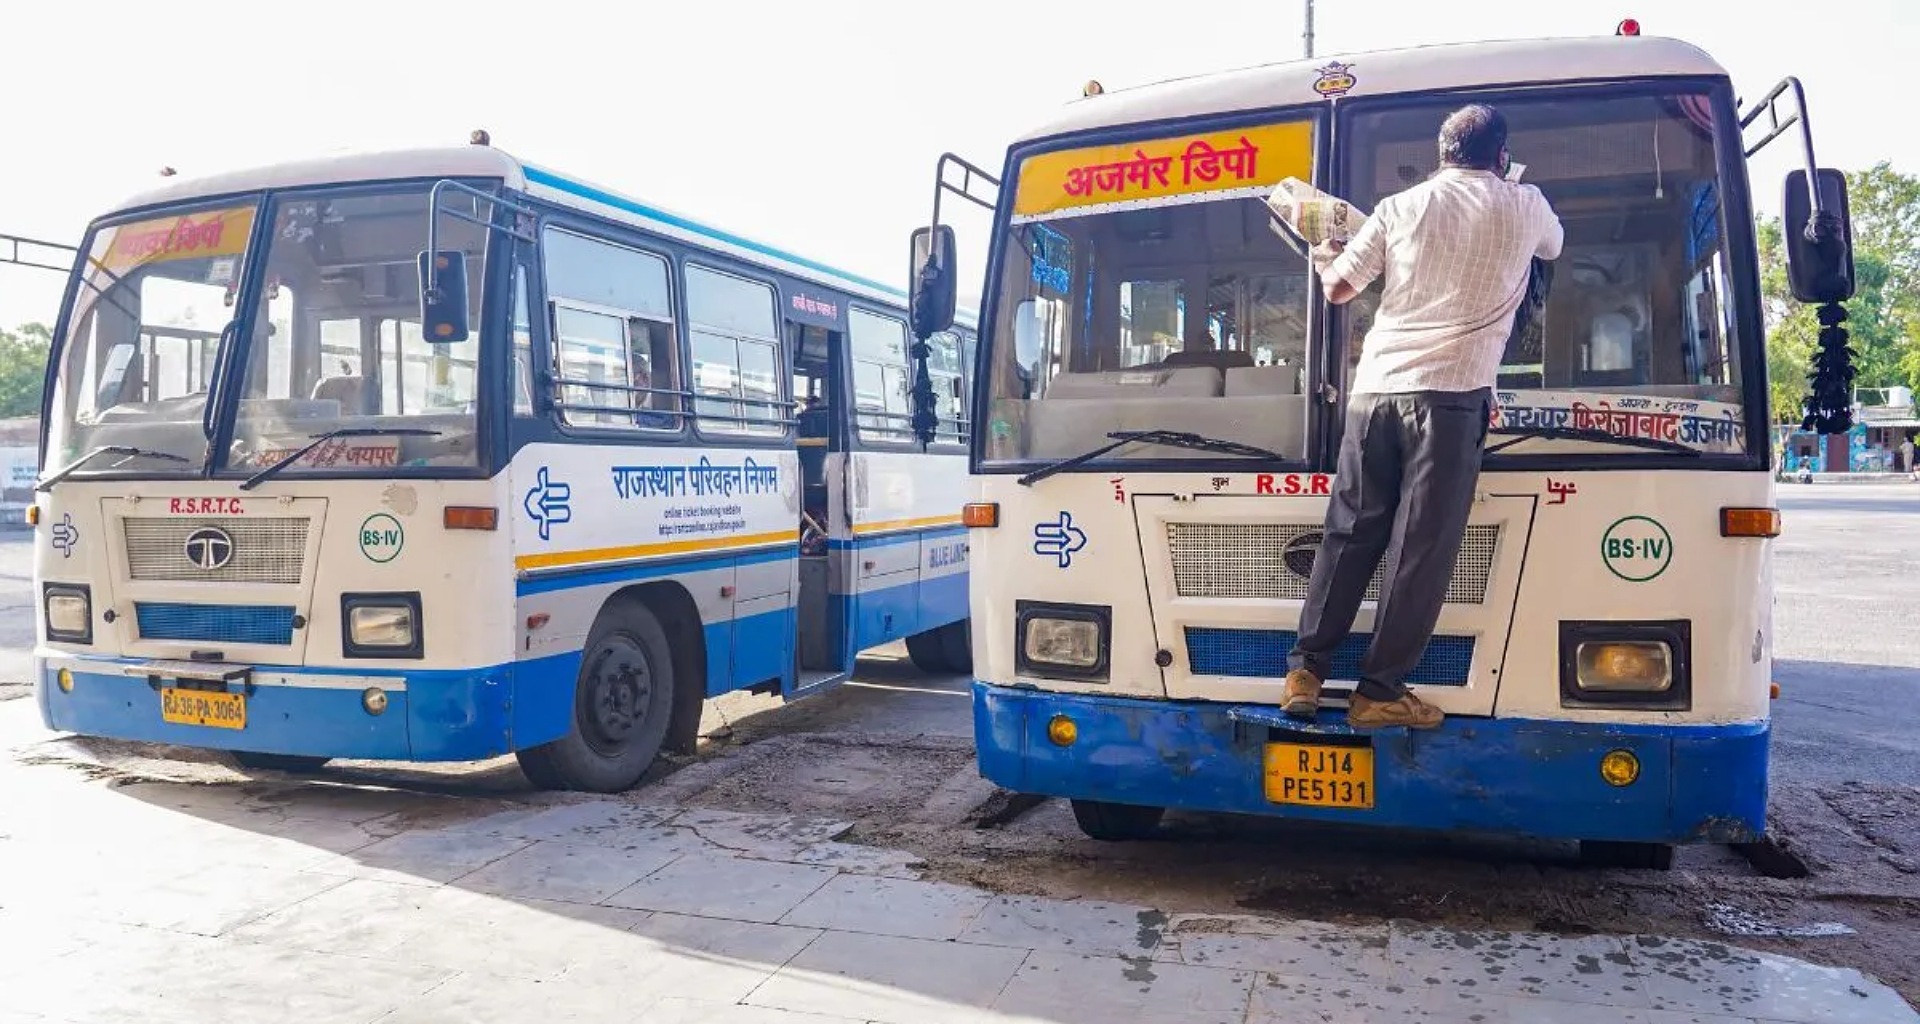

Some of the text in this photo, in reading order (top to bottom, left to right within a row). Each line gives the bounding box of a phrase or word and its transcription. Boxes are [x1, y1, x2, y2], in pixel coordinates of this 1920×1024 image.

[1064, 136, 1258, 196] अजमेर डिपो
[1504, 406, 1571, 430] जयपर
[612, 455, 777, 499] राजस्थान परिवहन निगम
[1256, 473, 1331, 495] R.S.R
[170, 497, 244, 513] R.S.R.T.C.
[1298, 749, 1354, 775] RJ14
[1283, 777, 1367, 804] PE5131
